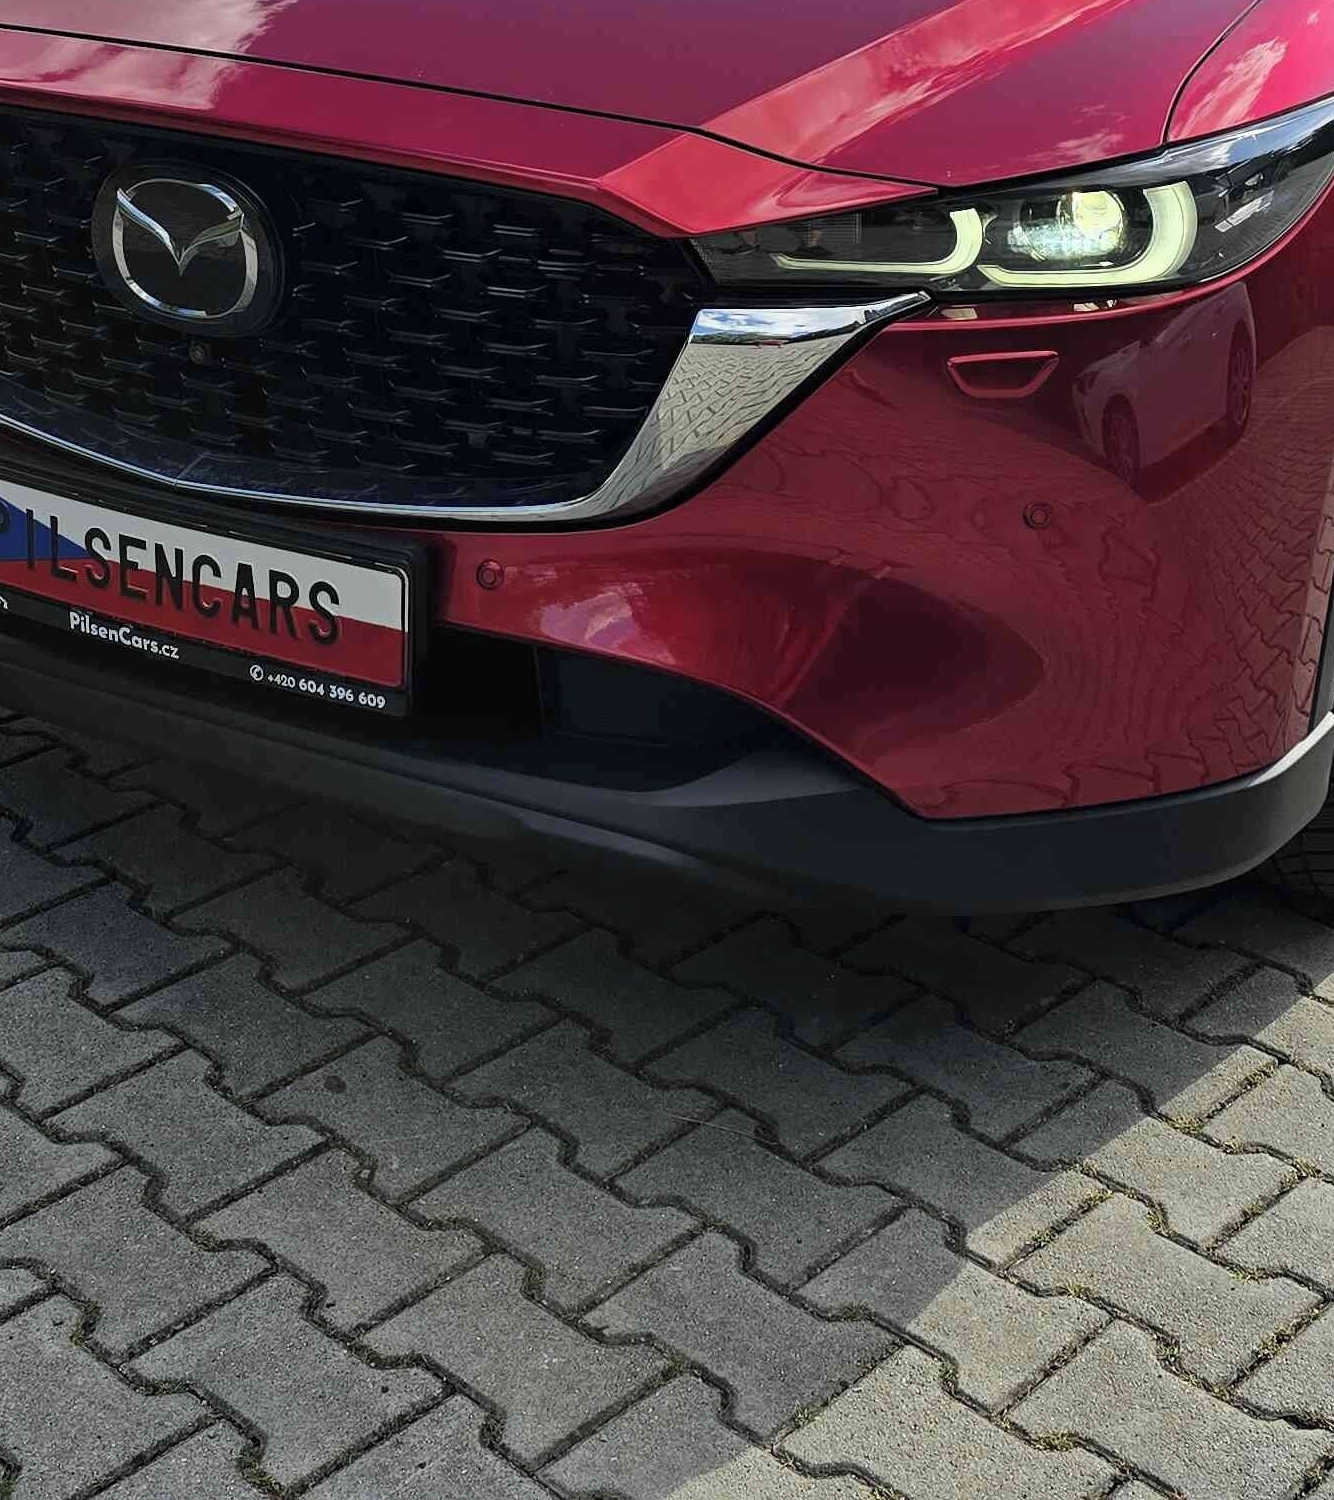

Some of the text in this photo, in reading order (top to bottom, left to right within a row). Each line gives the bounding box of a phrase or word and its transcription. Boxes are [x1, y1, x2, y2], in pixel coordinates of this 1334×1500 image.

[69, 611, 180, 660] PilsenCars.cz
[267, 673, 386, 709] +420 604 396 609
